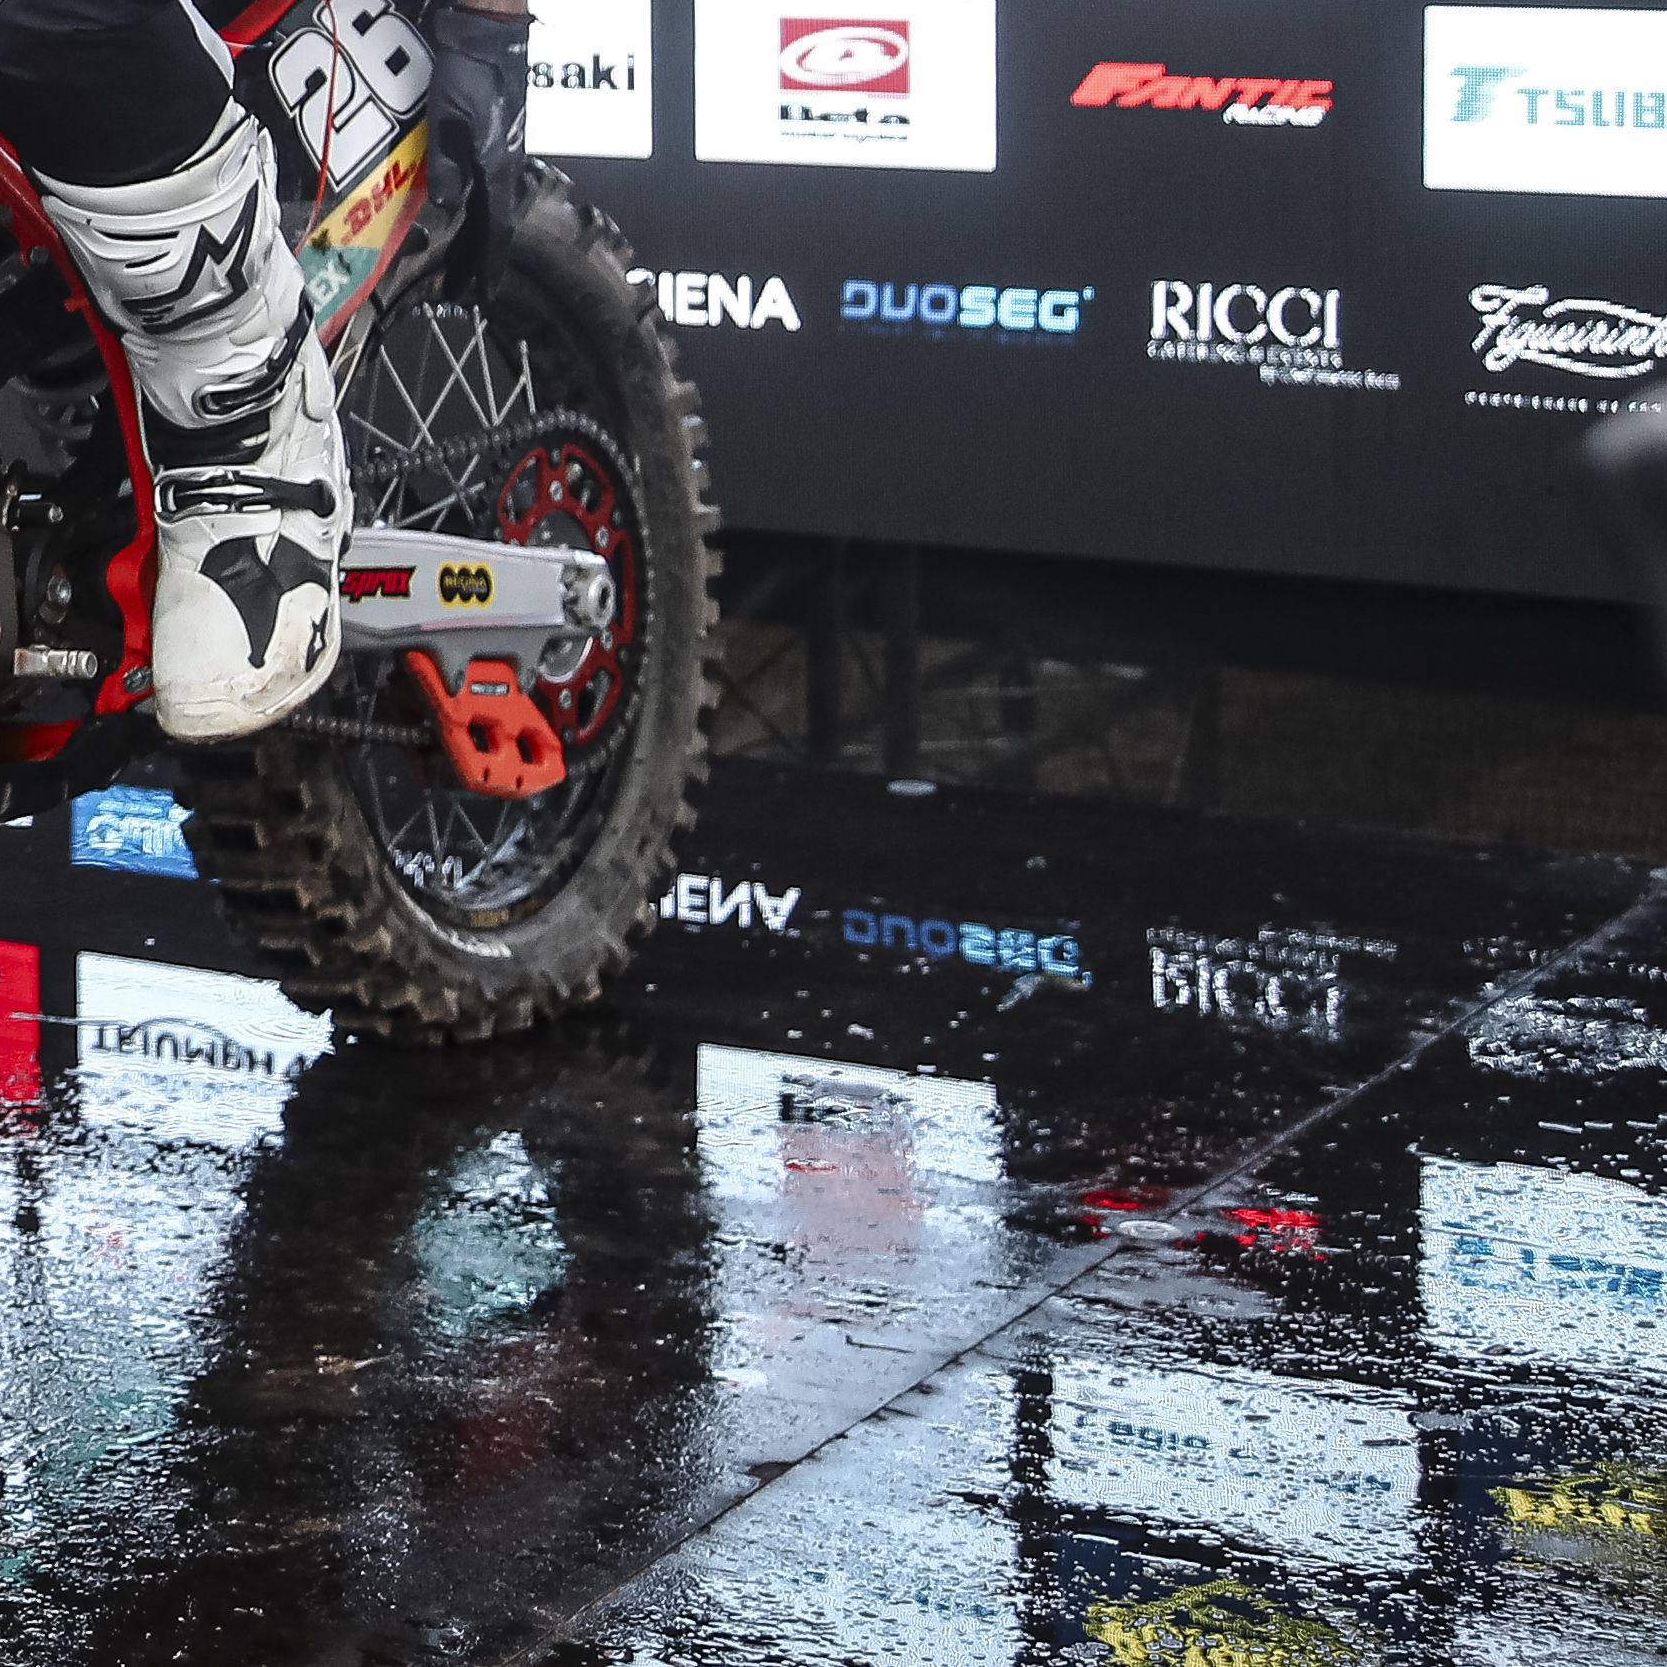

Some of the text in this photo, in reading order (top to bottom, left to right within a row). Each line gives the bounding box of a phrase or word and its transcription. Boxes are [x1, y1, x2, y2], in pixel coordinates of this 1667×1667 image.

[1071, 62, 1334, 111] FANTIC
[342, 163, 412, 234] DHL
[840, 279, 1083, 335] DUOSEG
[1150, 279, 1342, 352] RICCI
